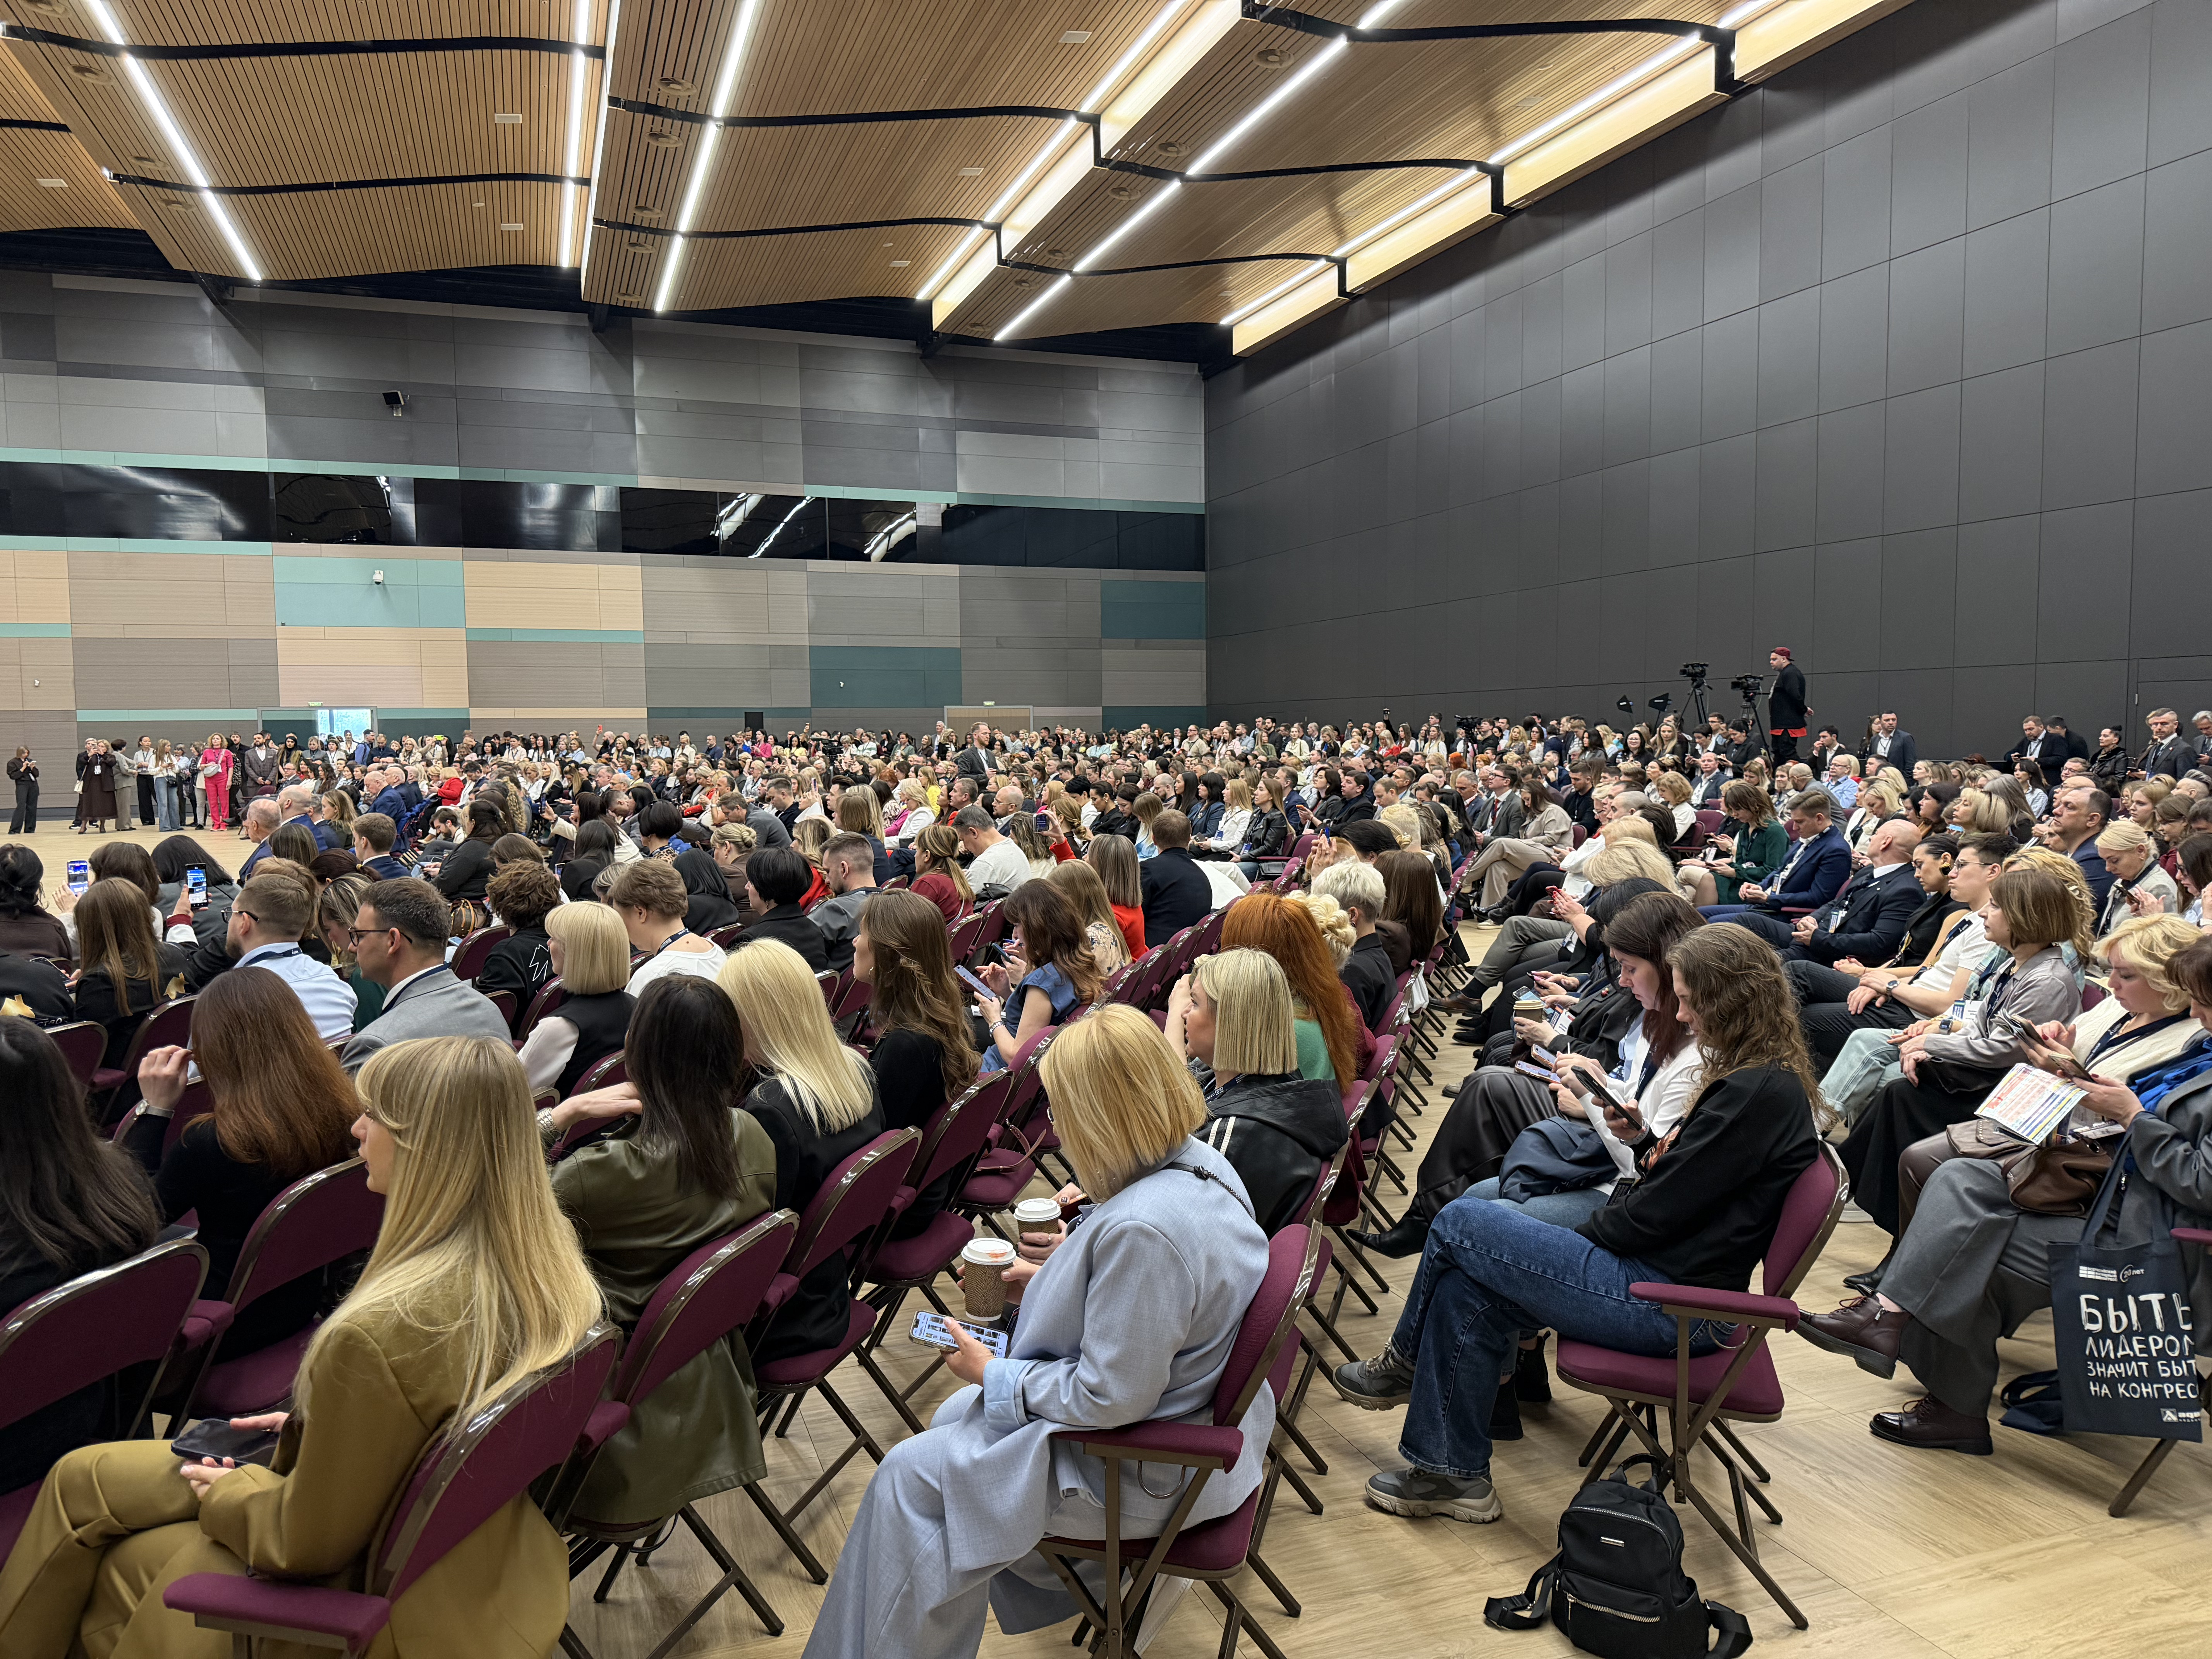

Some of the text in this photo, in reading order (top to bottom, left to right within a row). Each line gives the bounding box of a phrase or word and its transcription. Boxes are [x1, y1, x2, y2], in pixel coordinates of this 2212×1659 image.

[2079, 1292, 2193, 1334] БЫТЬ
[2087, 1361, 2149, 1378] ЗНАЧИТ
[2090, 1381, 2199, 1399] НА КОНГРЕС
